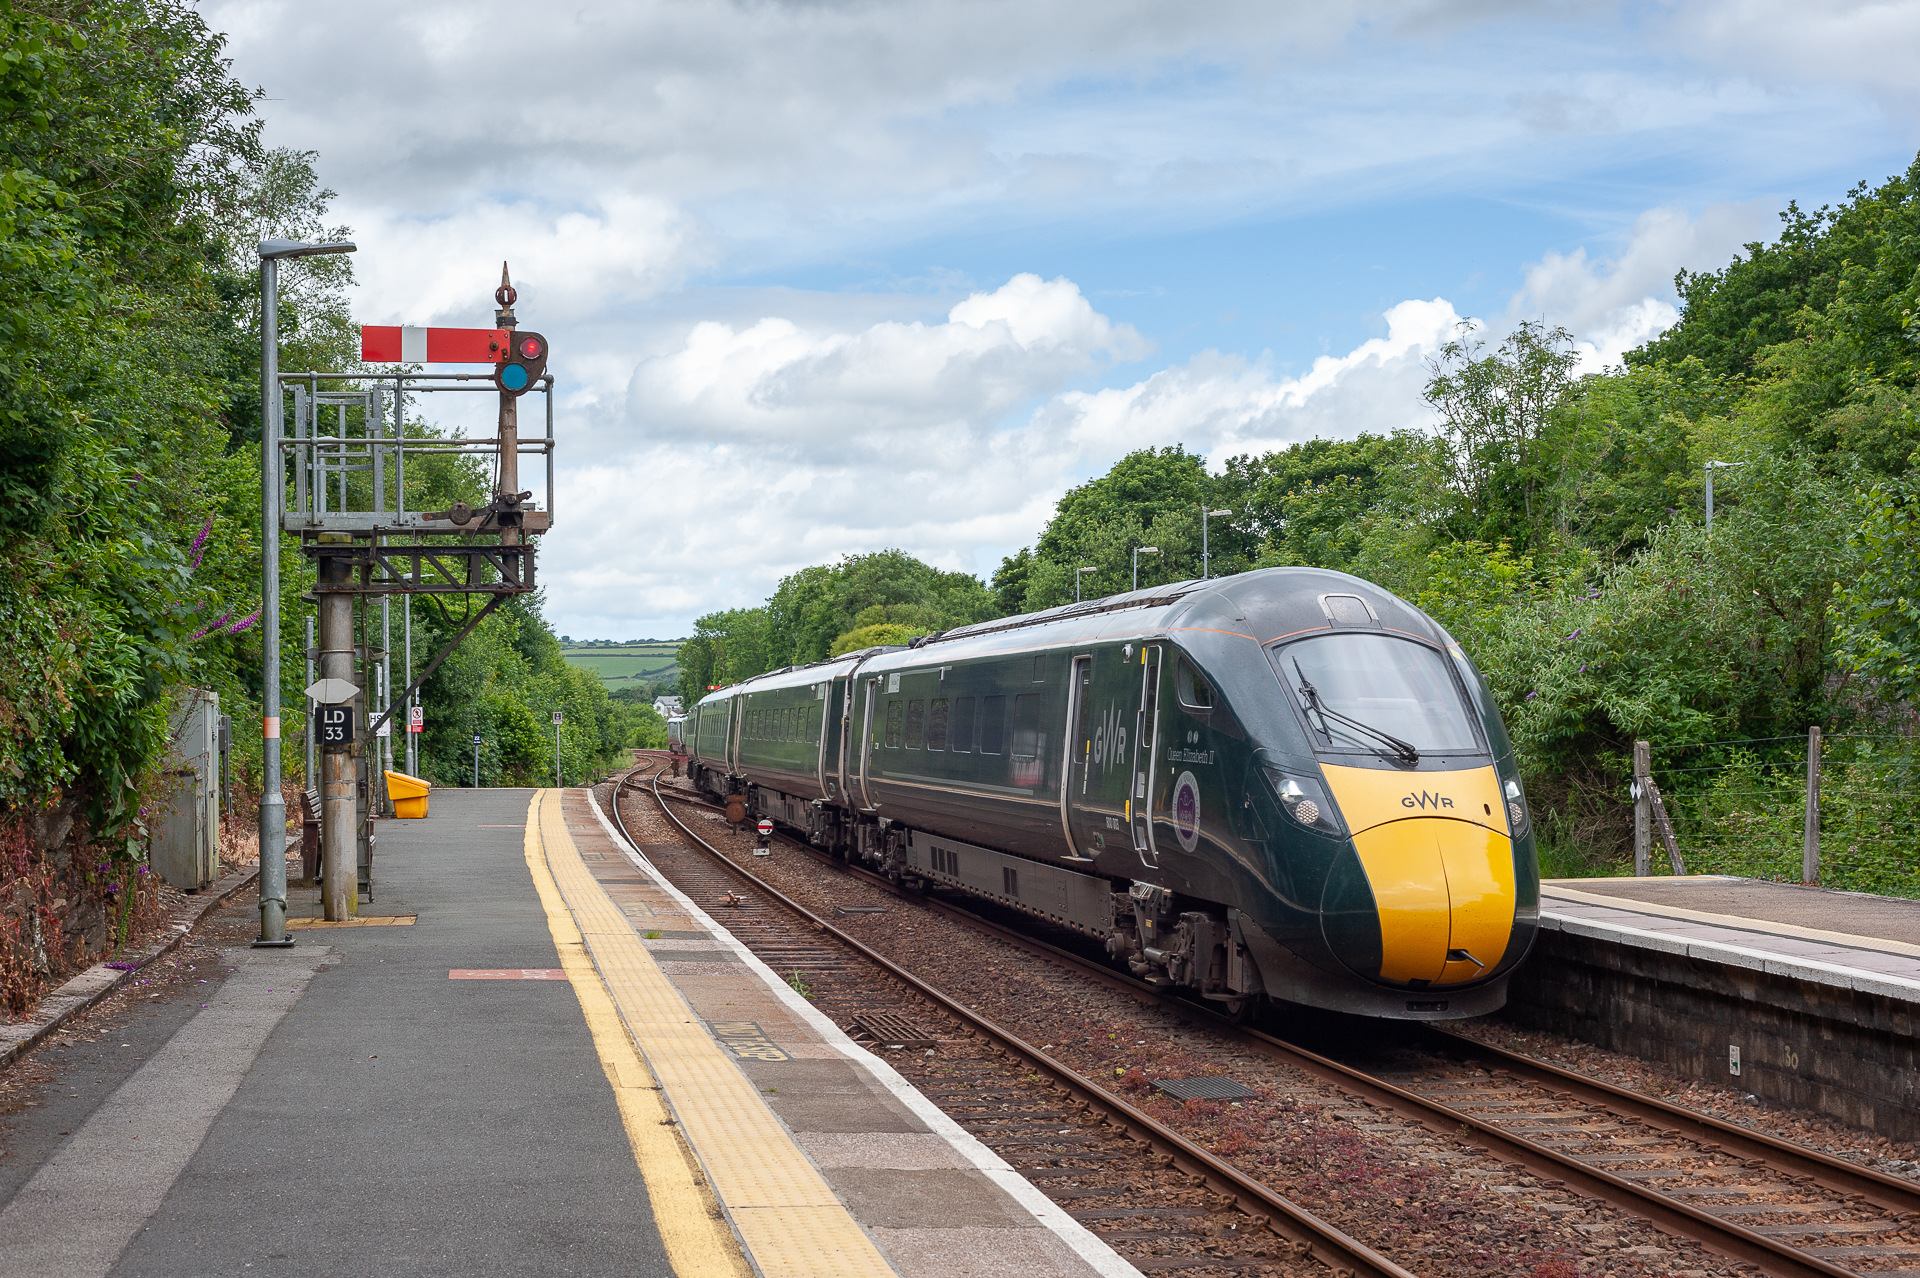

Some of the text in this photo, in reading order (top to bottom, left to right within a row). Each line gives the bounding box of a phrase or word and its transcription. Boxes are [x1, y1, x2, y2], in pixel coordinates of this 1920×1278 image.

[324, 710, 345, 724] LD
[325, 726, 344, 741] 33
[1094, 698, 1127, 776] GWR
[1401, 789, 1455, 810] GWR
[1784, 1045, 1799, 1070] 30
